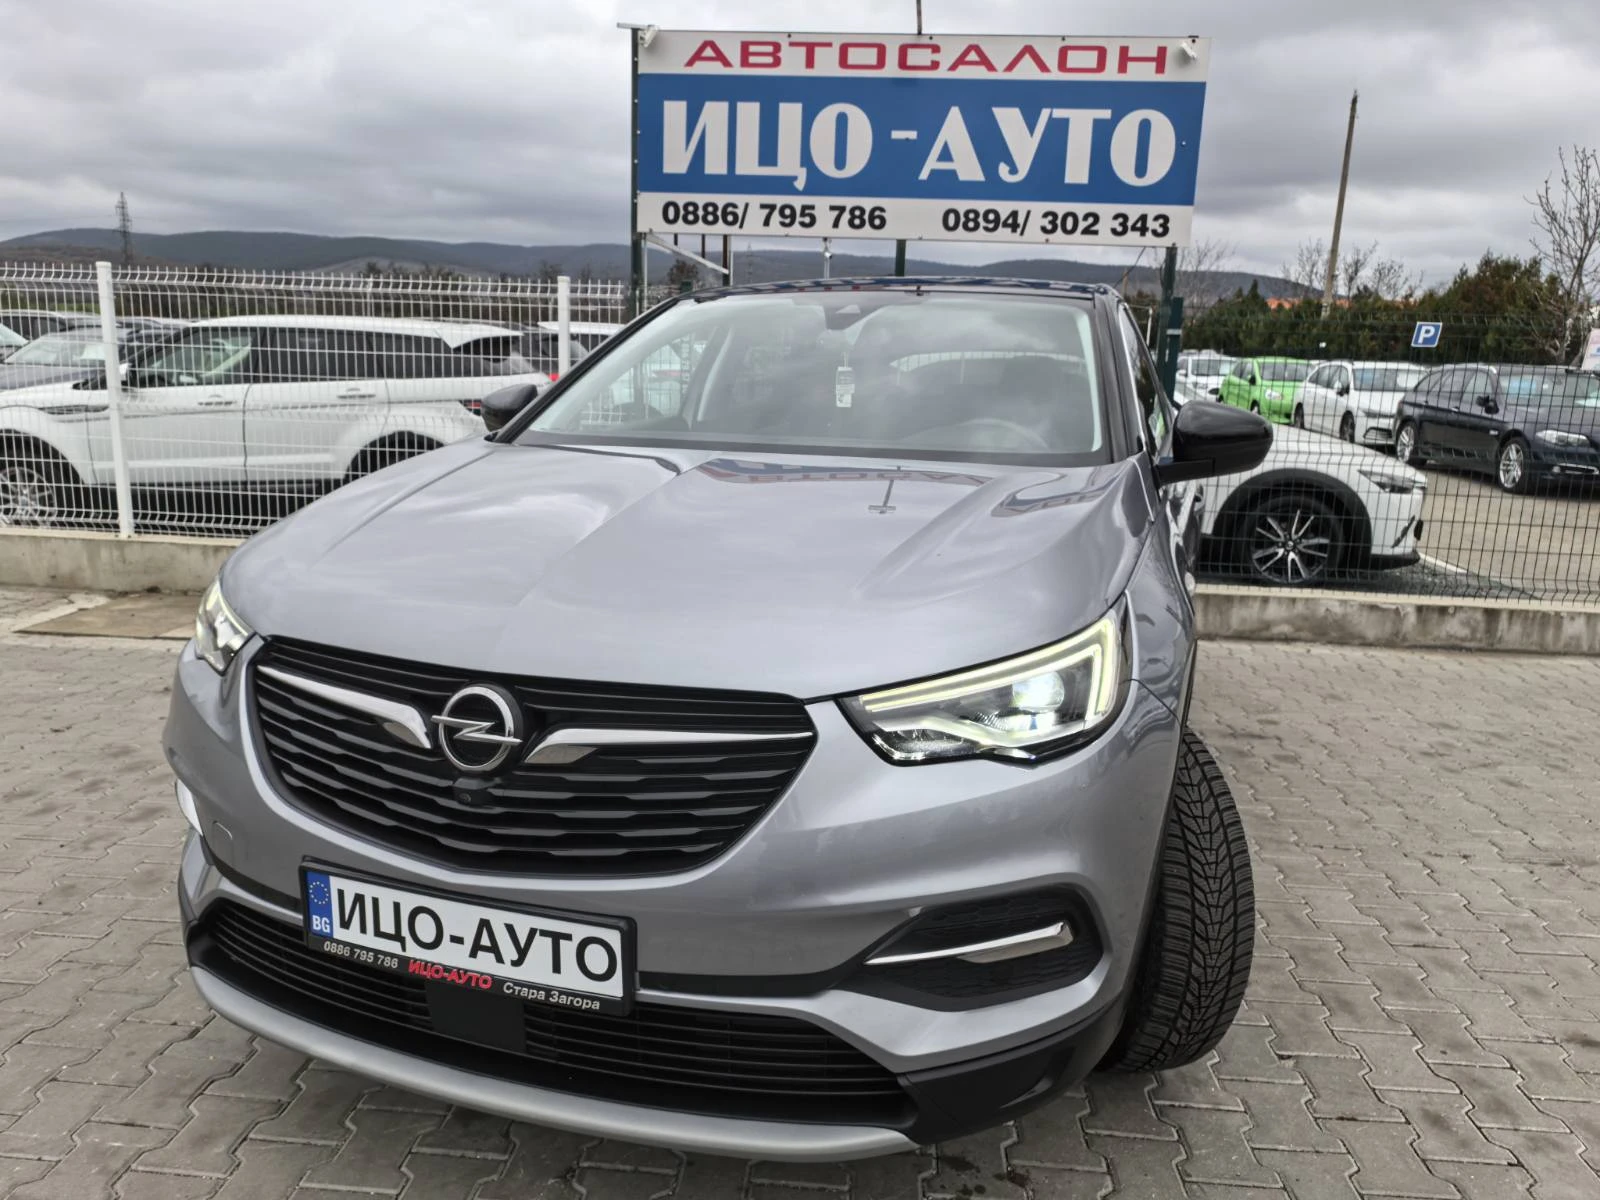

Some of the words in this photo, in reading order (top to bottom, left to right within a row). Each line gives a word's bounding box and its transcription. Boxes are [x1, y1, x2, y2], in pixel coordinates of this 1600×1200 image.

[684, 39, 1167, 74] АВТОСАЛОН
[662, 201, 749, 228] 0886/
[760, 204, 817, 228] 795
[829, 206, 887, 230] 786
[942, 208, 1030, 236] 0894/
[1040, 211, 1100, 235] 302
[1110, 214, 1170, 238] 343
[1418, 325, 1435, 344] P
[312, 915, 331, 933] BG
[337, 888, 618, 982] ИЦО-АУТО
[323, 941, 351, 956] 0886
[353, 949, 374, 963] 795
[377, 953, 399, 969] 786
[408, 959, 493, 989] ИЦО-АУТО
[503, 982, 546, 1001] Стара
[549, 991, 601, 1010] Загора
